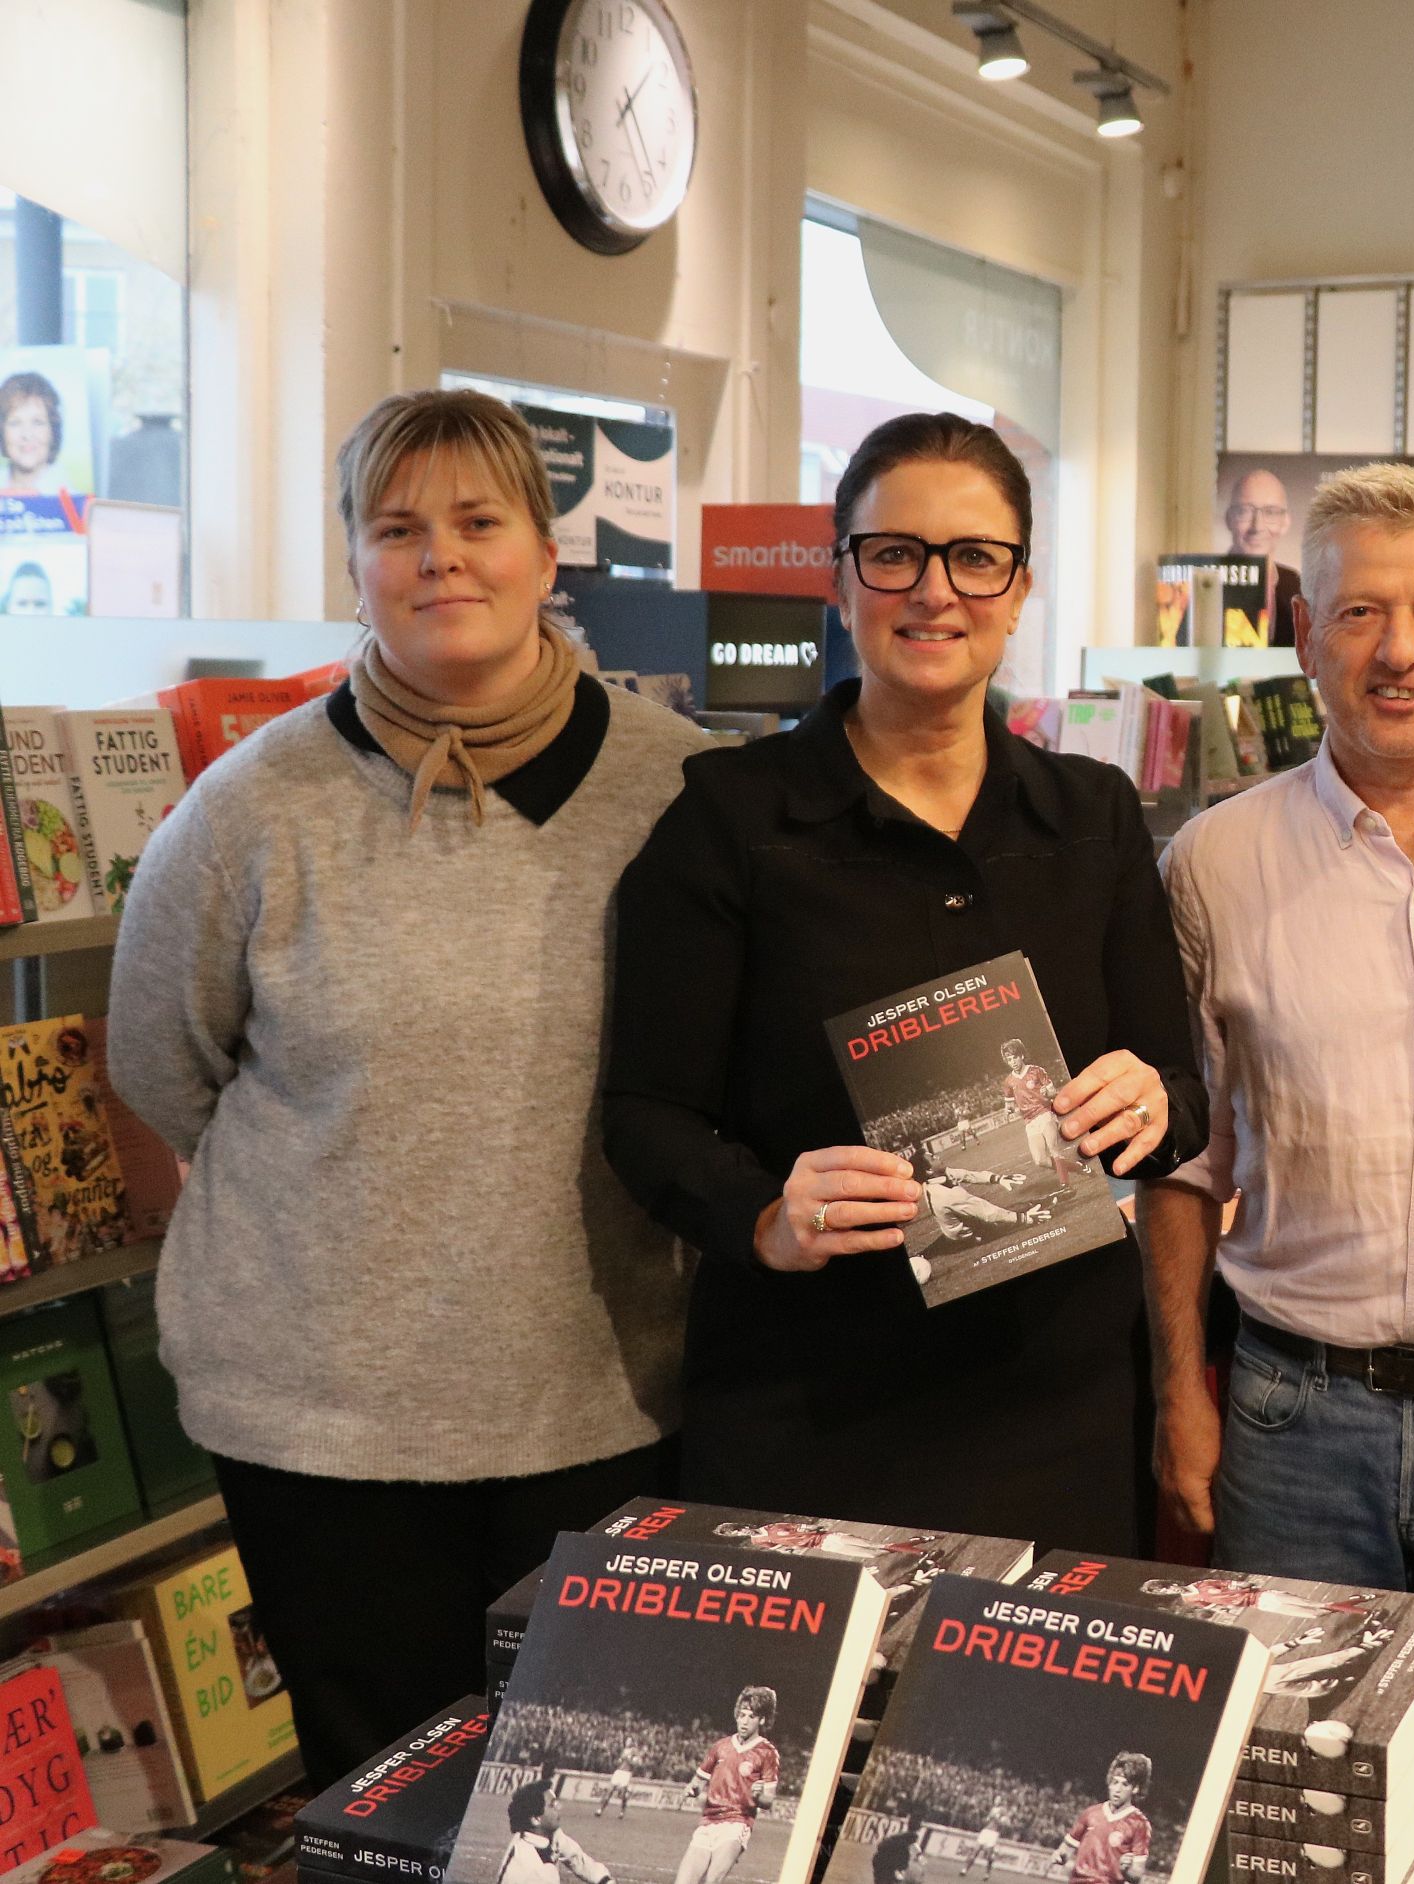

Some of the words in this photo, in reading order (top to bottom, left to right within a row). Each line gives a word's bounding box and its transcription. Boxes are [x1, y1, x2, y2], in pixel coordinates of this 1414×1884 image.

[581, 119, 593, 148] 8
[604, 480, 663, 504] KONTUR
[711, 642, 737, 666] GO
[740, 642, 799, 667] DREAM
[227, 692, 255, 703] JAMIE
[258, 692, 291, 703] OLIVER
[8, 730, 44, 751] UND
[95, 730, 158, 751] FATTIG
[14, 753, 65, 776] DENT
[93, 752, 170, 776] STUDENT
[70, 776, 87, 828] FATTIG
[81, 832, 105, 897] STUDENT
[868, 996, 930, 1028] JESPER
[934, 975, 988, 1002] OLSEN
[848, 981, 1021, 1060] DRIBLEREN
[981, 1244, 1020, 1264] STEFFEN
[1021, 1226, 1067, 1249] PEDERSEN
[1008, 1249, 1040, 1264] GYLDENDAL
[605, 1516, 637, 1537] SEN
[606, 1555, 699, 1580] JESPER
[707, 1564, 791, 1590] OLSEN
[1027, 1571, 1058, 1591] SEN
[173, 1567, 233, 1621] BARE
[559, 1575, 826, 1635] DRIBLEREN
[497, 1629, 526, 1640] STEFF
[983, 1600, 1080, 1634] JESPER
[1087, 1619, 1174, 1651] OLSEN
[493, 1640, 522, 1650] PEDER
[932, 1619, 1209, 1702] DRIBLEREN
[1379, 1656, 1405, 1690] STEFFEN
[195, 1676, 234, 1718] BID
[351, 1751, 413, 1793] JESPER
[409, 1717, 463, 1750] OLSEN
[300, 1844, 344, 1861] PEDERSEN
[303, 1835, 340, 1849] STEFFEN
[353, 1849, 423, 1876] JESPER
